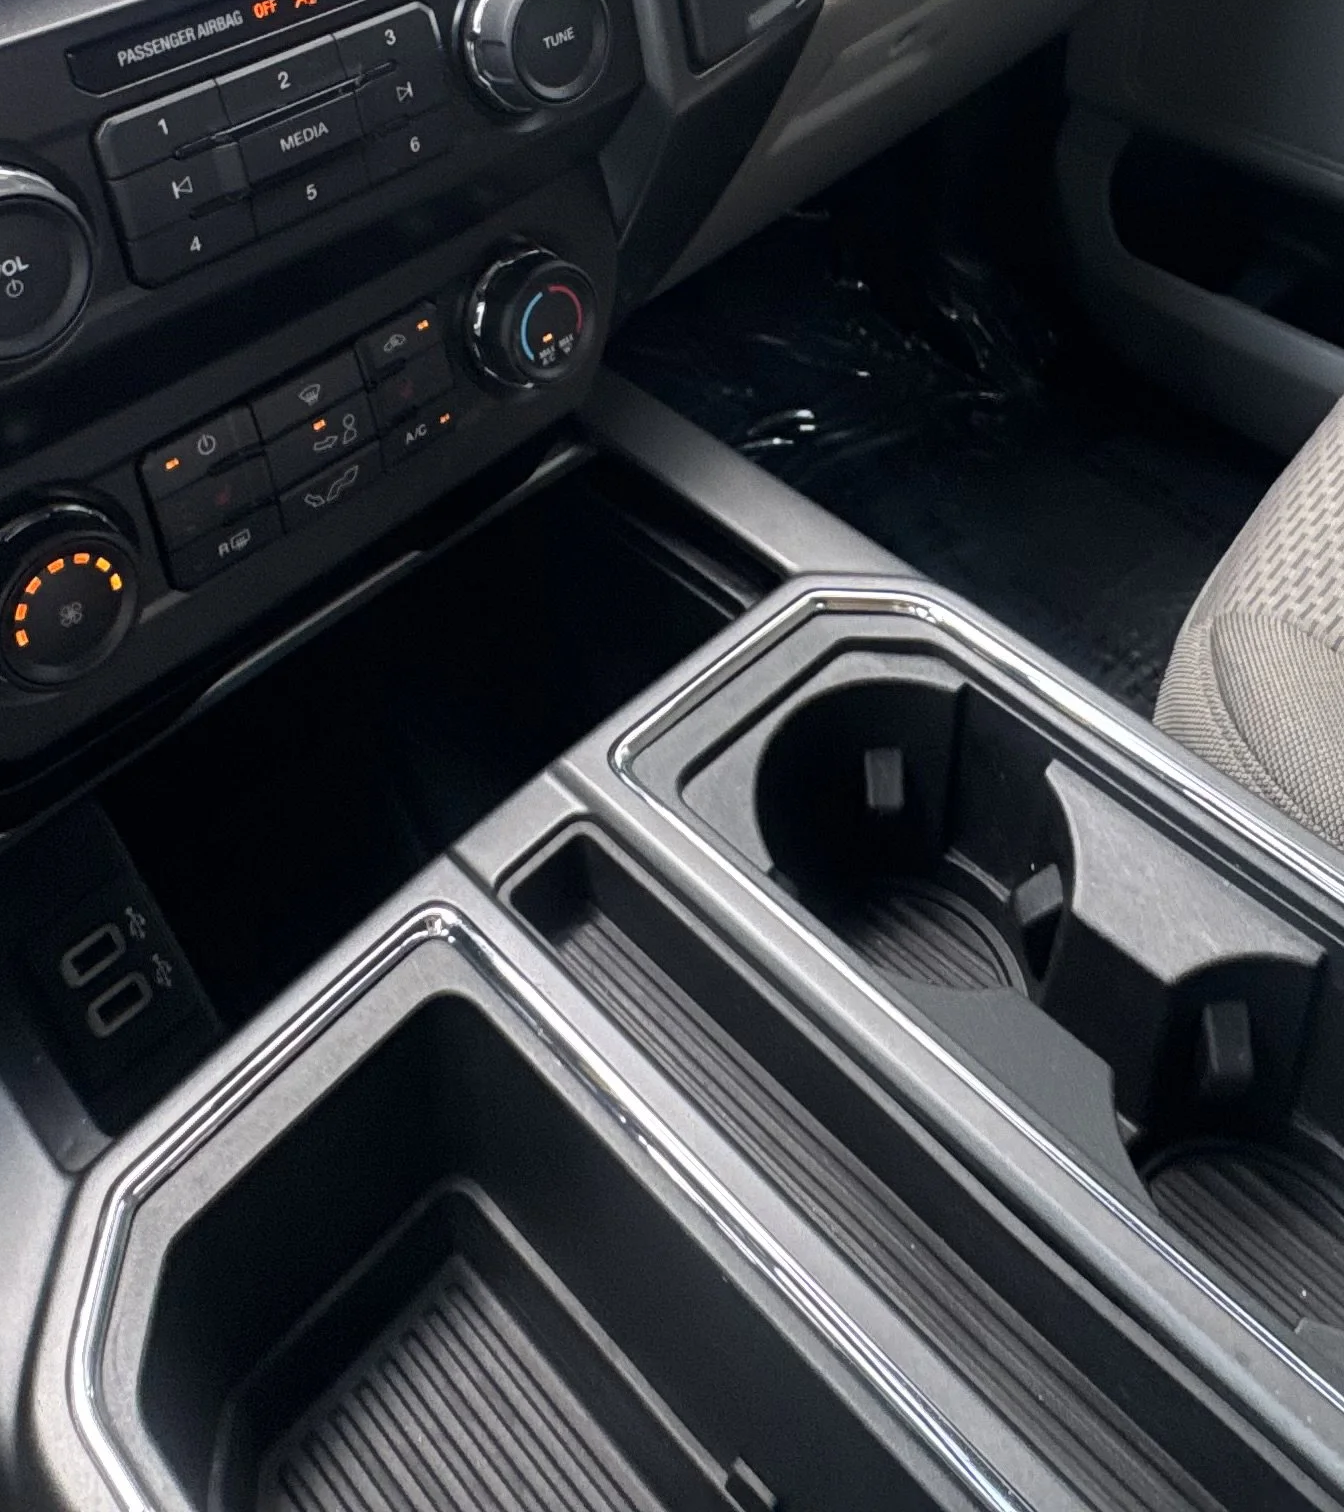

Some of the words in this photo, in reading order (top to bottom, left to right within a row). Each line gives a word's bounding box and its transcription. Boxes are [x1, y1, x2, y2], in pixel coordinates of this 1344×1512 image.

[117, 27, 197, 66] PASSENGER
[197, 9, 244, 39] AIRBAG
[384, 28, 397, 47] 3
[543, 26, 574, 49] TUNE
[277, 71, 292, 90] 2
[157, 117, 169, 136] 1
[279, 121, 330, 153] MEDIA
[409, 135, 421, 153] 6
[306, 183, 318, 201] 5
[189, 235, 202, 252] 4
[406, 423, 427, 445] A/C
